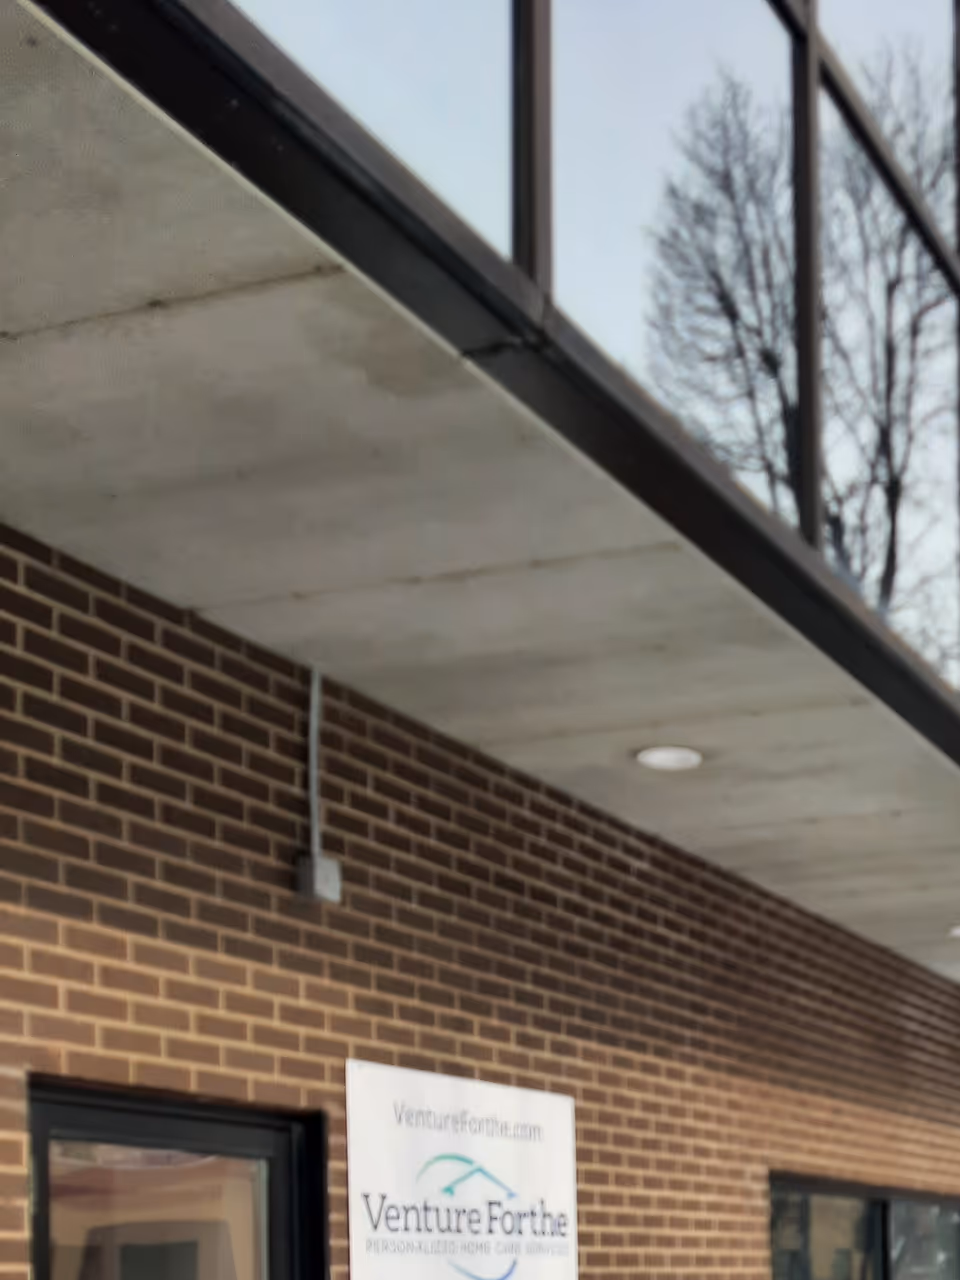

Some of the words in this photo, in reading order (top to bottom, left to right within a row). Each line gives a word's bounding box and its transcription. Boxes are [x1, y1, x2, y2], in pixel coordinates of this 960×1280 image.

[394, 1101, 543, 1141] VentureForthe.com
[362, 1192, 481, 1235] Venture
[487, 1199, 569, 1237] Forthe
